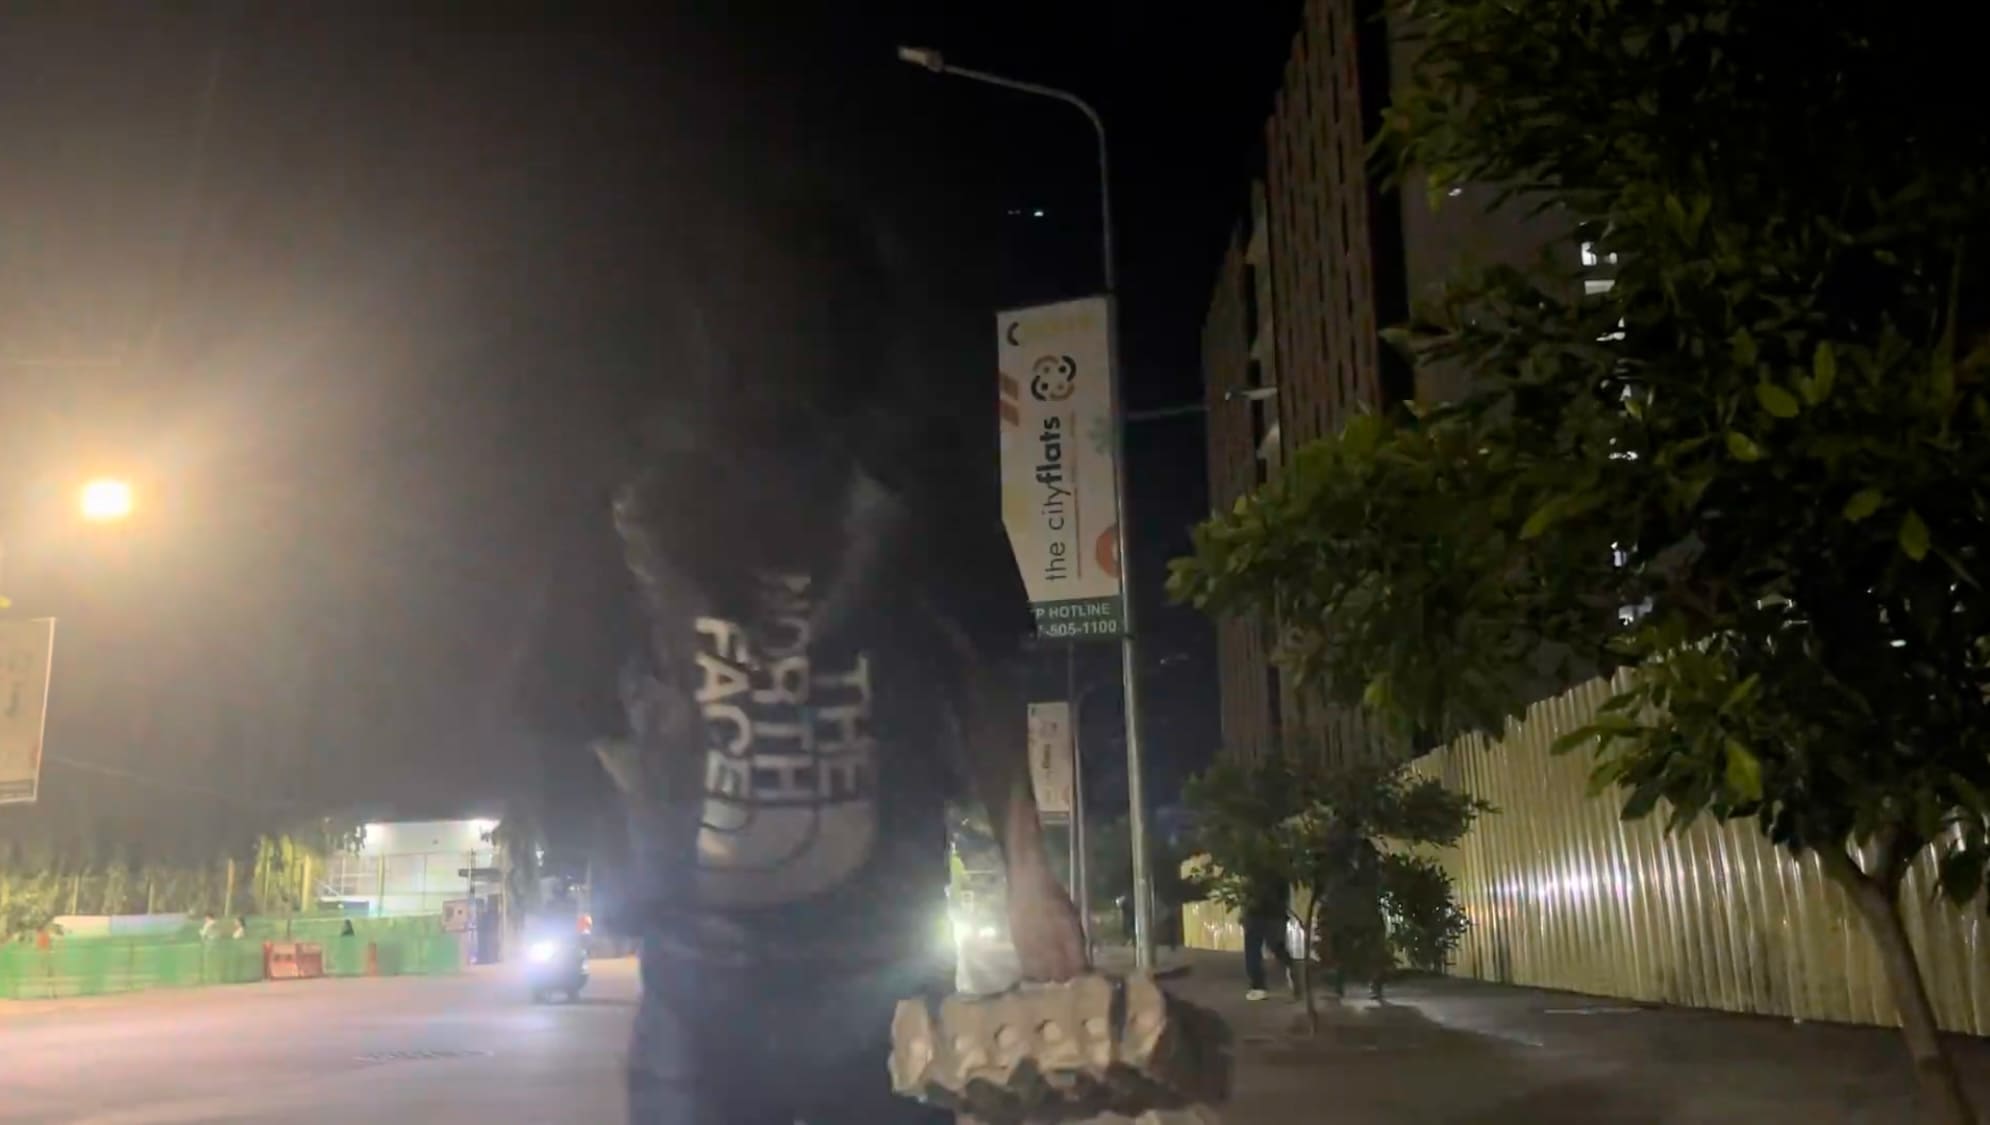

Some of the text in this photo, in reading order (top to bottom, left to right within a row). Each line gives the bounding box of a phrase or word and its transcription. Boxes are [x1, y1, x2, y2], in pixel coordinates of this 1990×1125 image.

[1045, 541, 1067, 581] the
[1048, 603, 1111, 618] HOTLINE
[694, 617, 756, 795] FACE
[814, 652, 873, 797] THE
